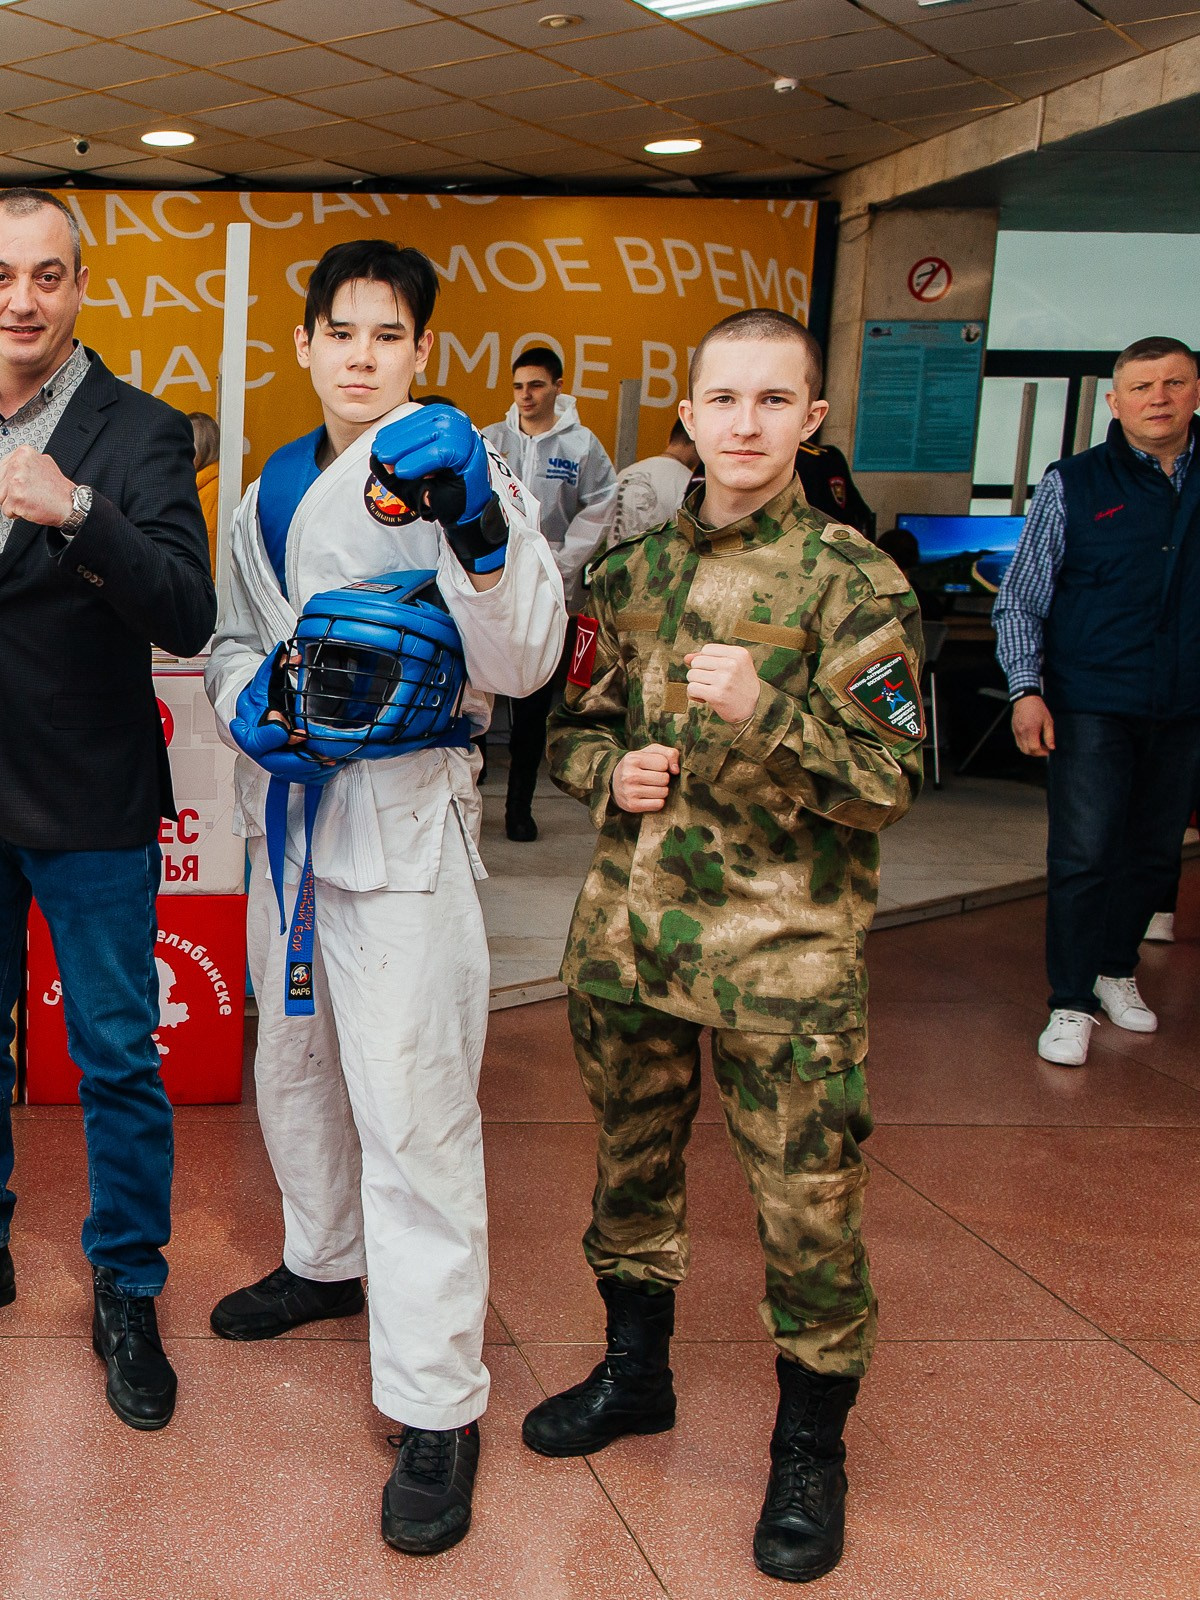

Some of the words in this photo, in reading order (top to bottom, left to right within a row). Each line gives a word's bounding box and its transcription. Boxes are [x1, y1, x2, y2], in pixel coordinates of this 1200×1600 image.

[614, 237, 808, 328] ВРЕМЯ
[156, 929, 232, 1016] елябинске
[290, 987, 311, 996] ФАРБ
